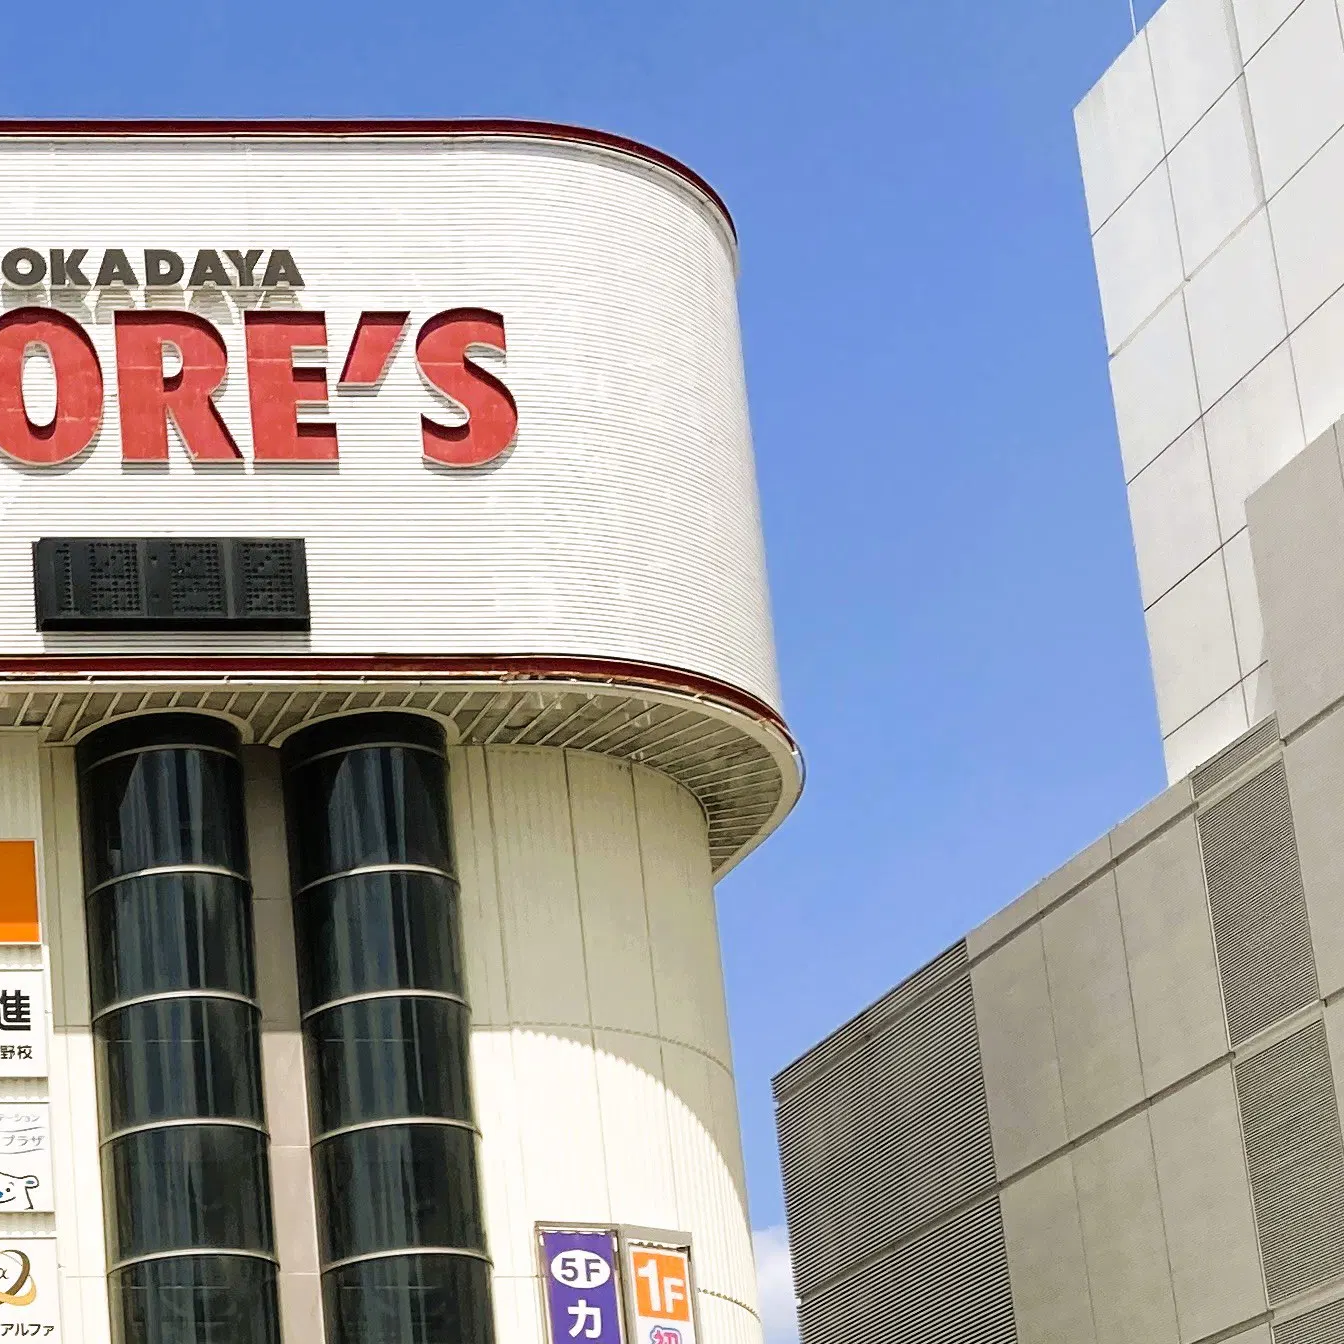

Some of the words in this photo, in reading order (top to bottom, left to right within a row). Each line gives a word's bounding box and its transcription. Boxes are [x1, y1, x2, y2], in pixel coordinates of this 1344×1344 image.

[1, 247, 305, 288] OKADAYA
[561, 1257, 601, 1282] 5F
[638, 1259, 685, 1313] 1F
[0, 1323, 55, 1337] アルファ
